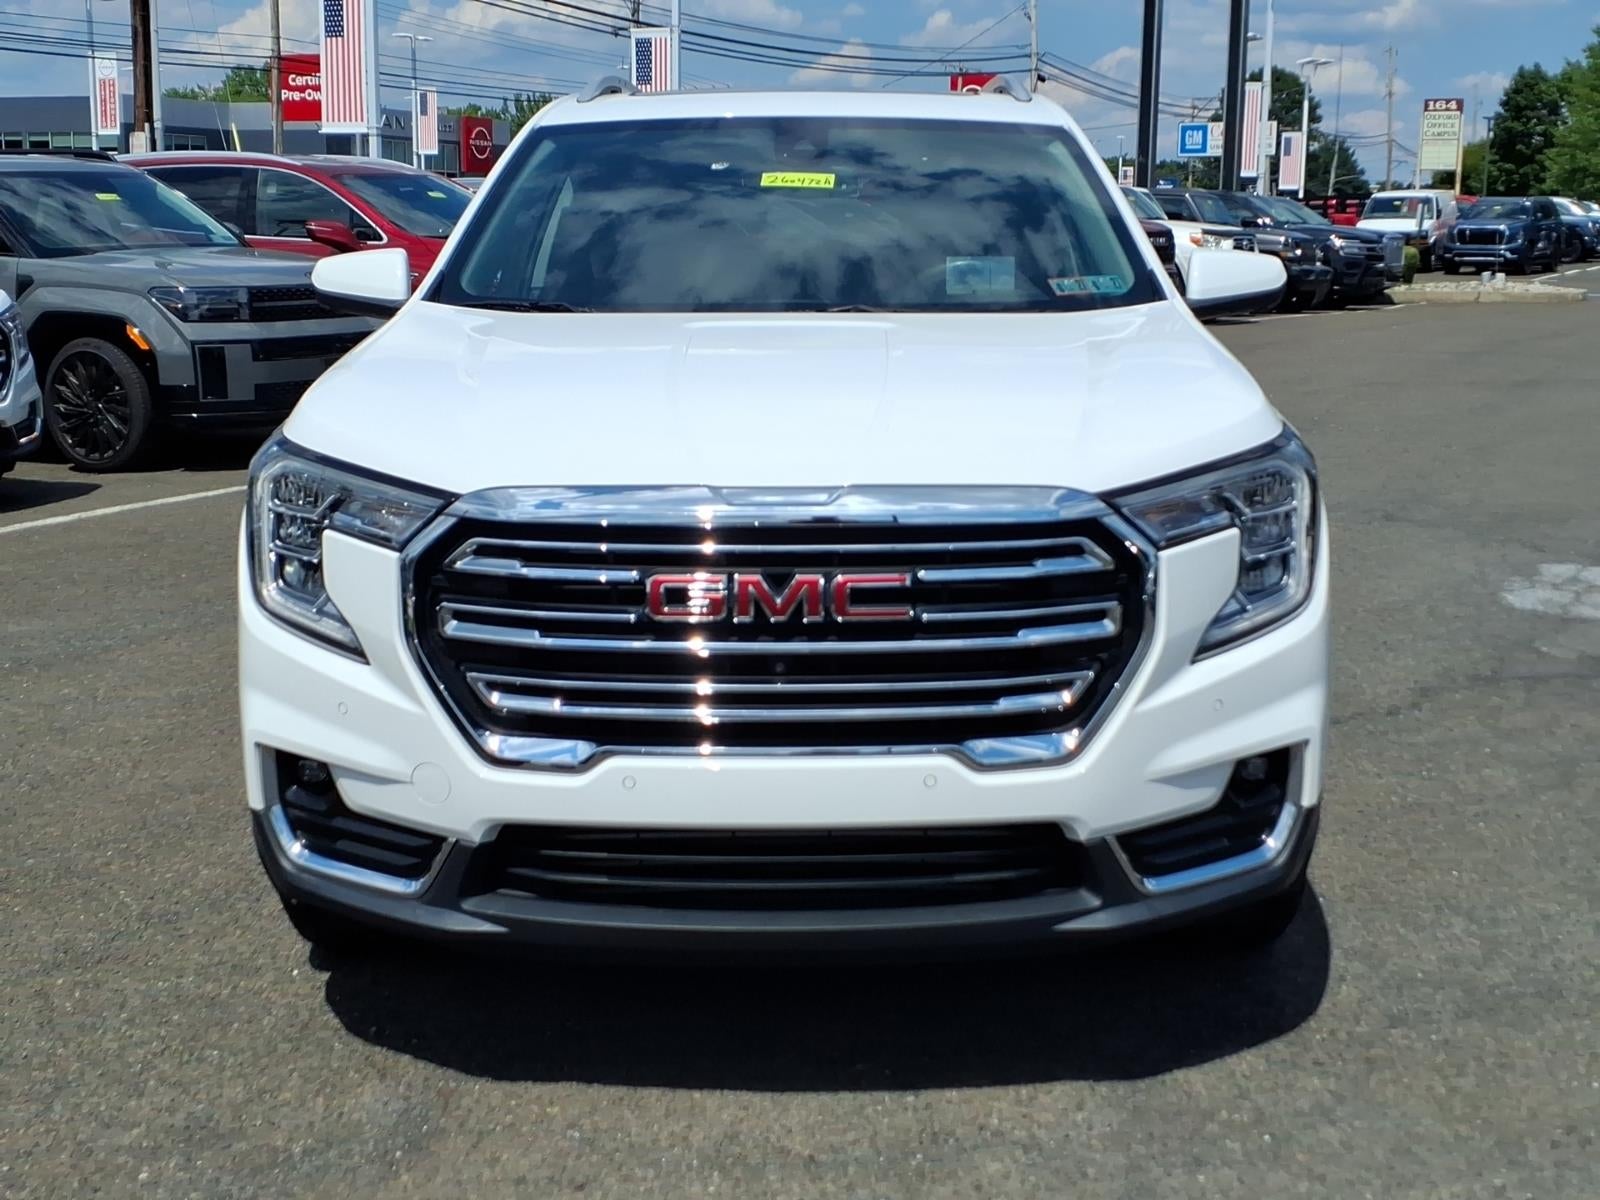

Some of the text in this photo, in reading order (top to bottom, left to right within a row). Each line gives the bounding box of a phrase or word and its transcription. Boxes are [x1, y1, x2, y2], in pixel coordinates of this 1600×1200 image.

[1427, 100, 1457, 110] 164
[1185, 129, 1203, 145] GM
[645, 572, 913, 623] GMC
